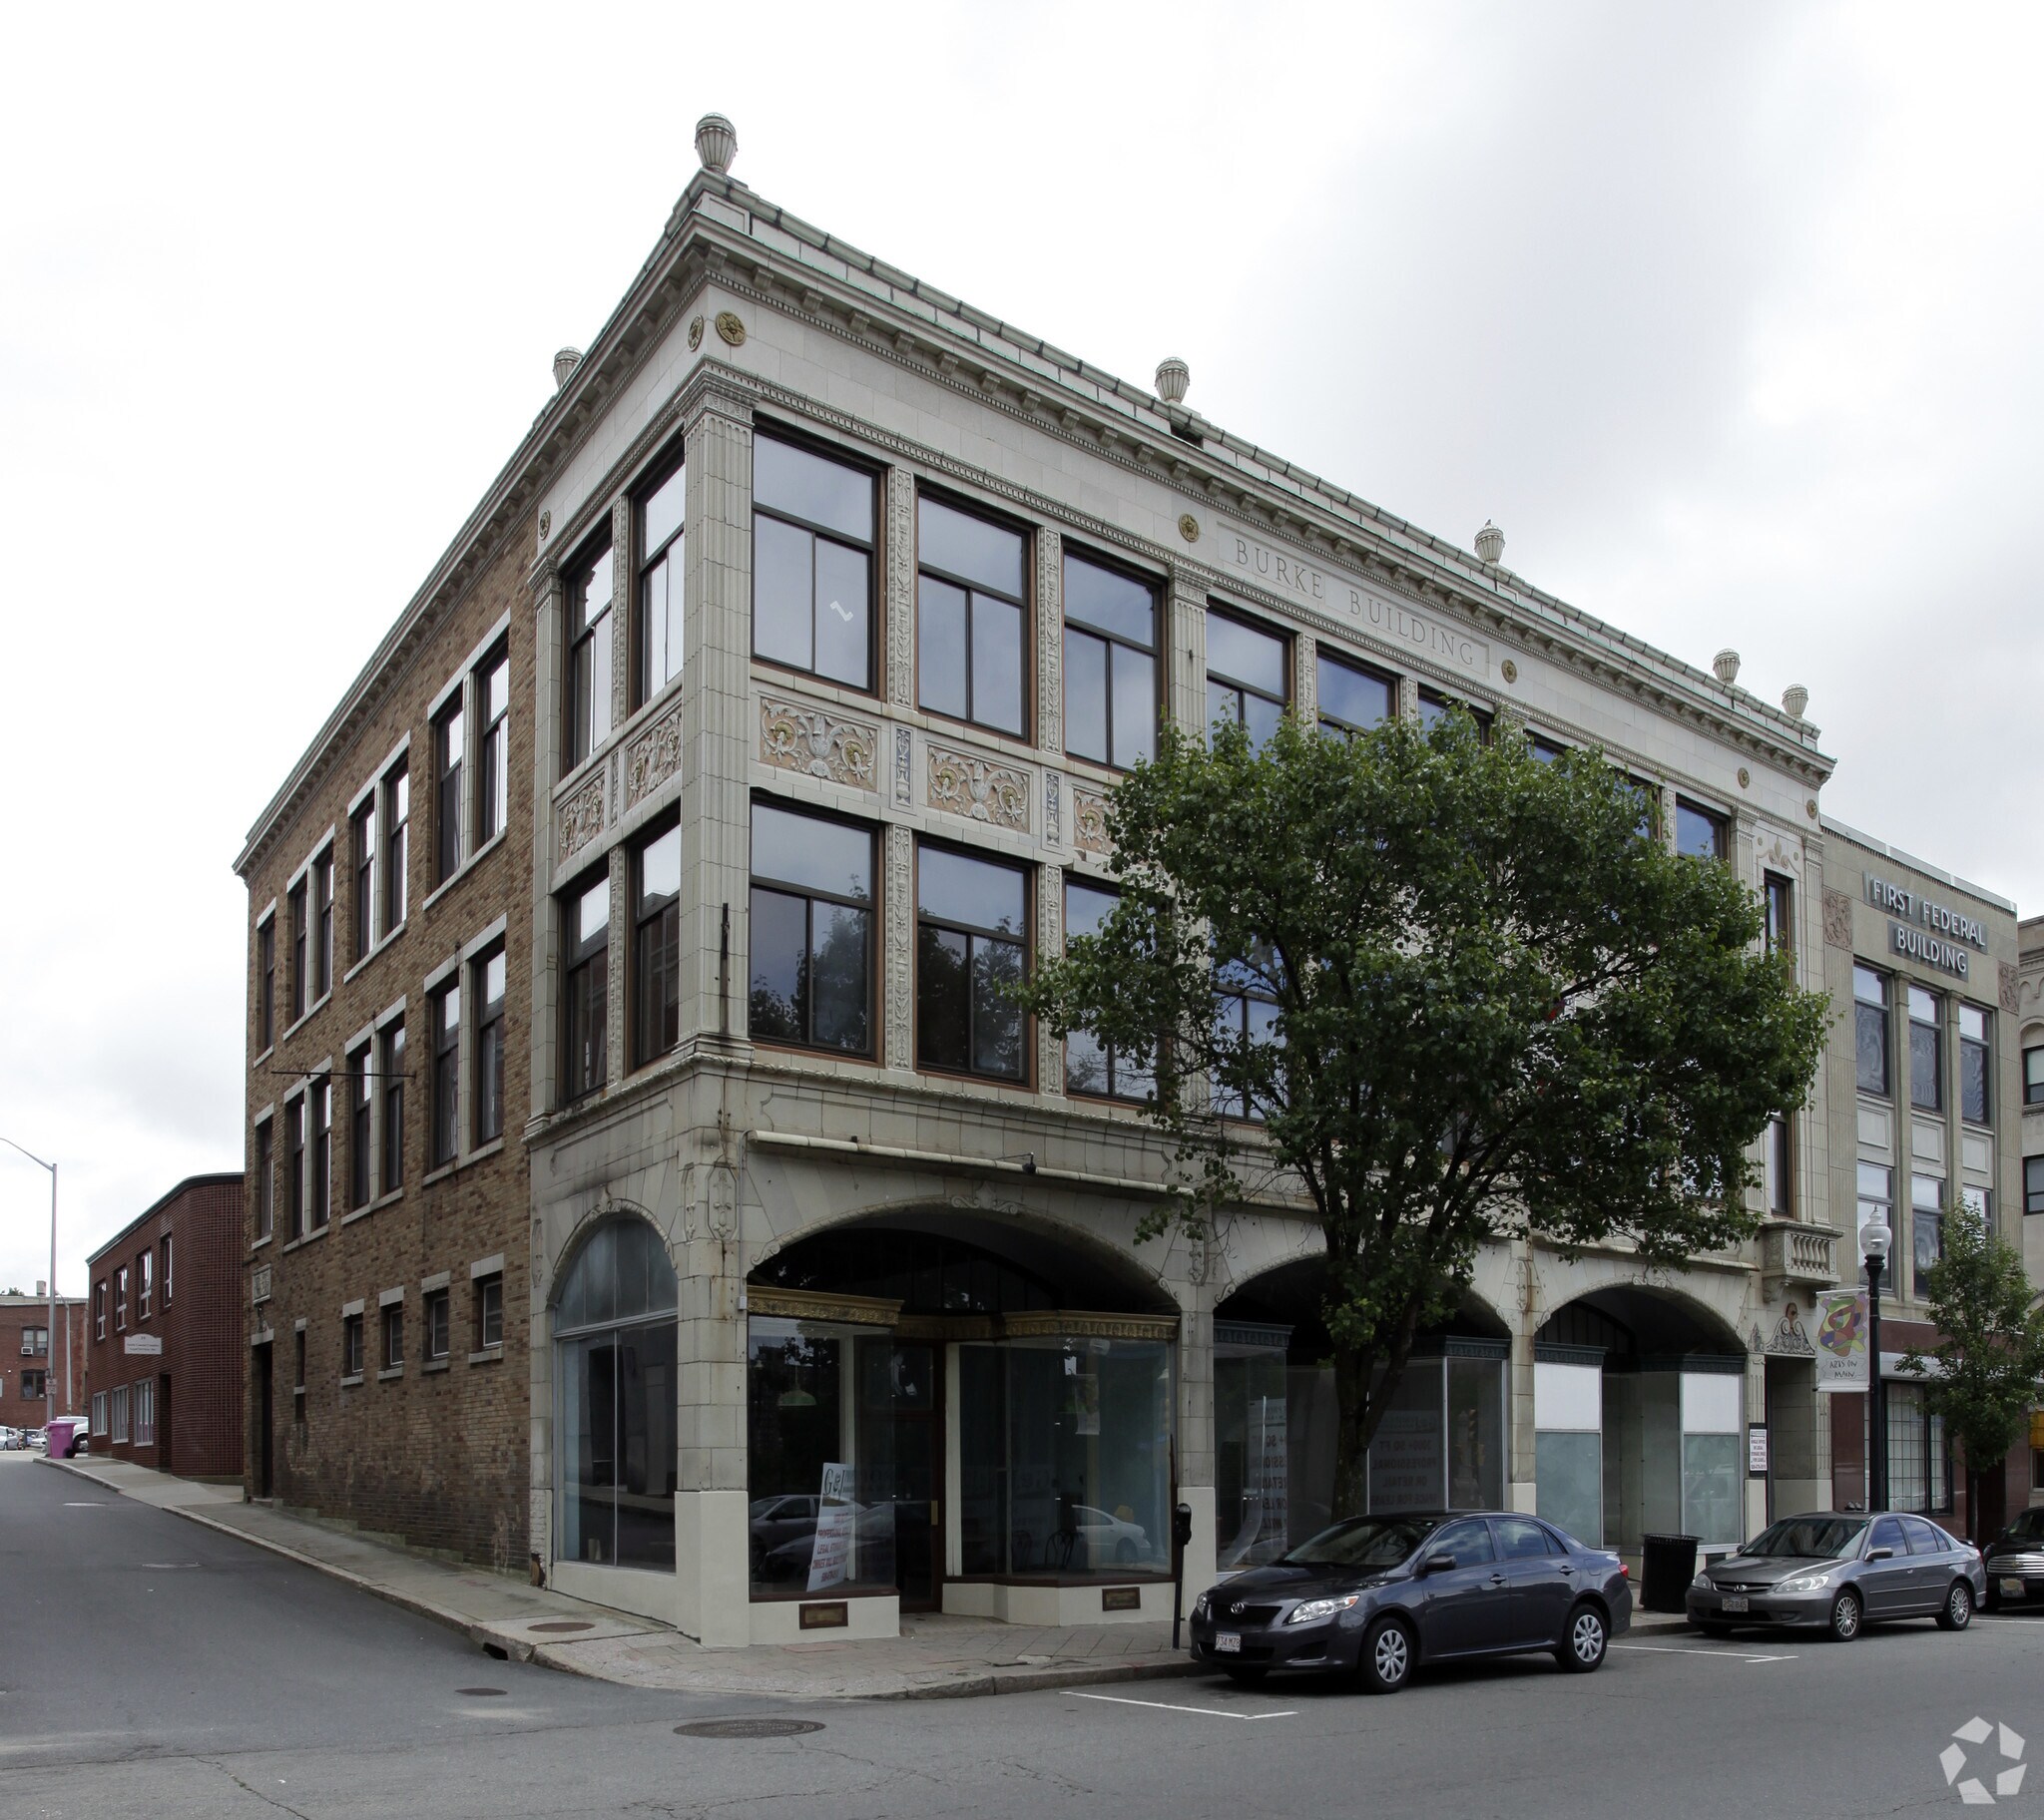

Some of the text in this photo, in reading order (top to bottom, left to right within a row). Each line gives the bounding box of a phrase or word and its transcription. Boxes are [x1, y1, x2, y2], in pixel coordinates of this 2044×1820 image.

[1235, 538, 1474, 666] BURKE BUILDING
[1871, 878, 1986, 947] FIRST FEDERAL
[1896, 925, 1967, 973] BUILDING
[1829, 1359, 1845, 1369] ARTS
[1834, 1370, 1855, 1379] MAIN
